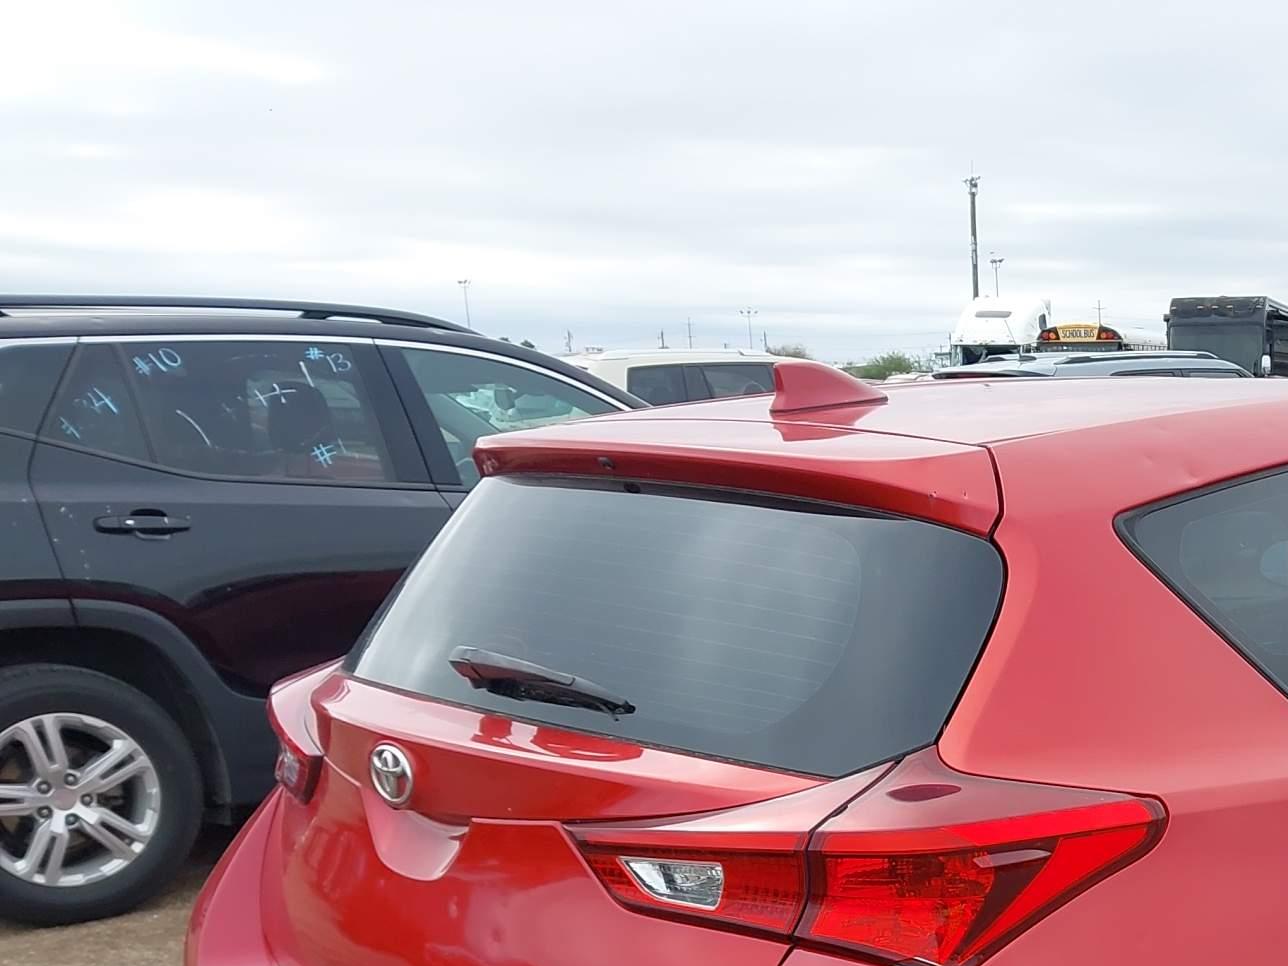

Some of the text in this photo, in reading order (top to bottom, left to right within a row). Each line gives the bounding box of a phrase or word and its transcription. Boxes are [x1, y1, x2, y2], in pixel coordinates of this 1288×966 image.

[1061, 328, 1095, 338] SCHOOL BUS
[133, 348, 181, 375] #10
